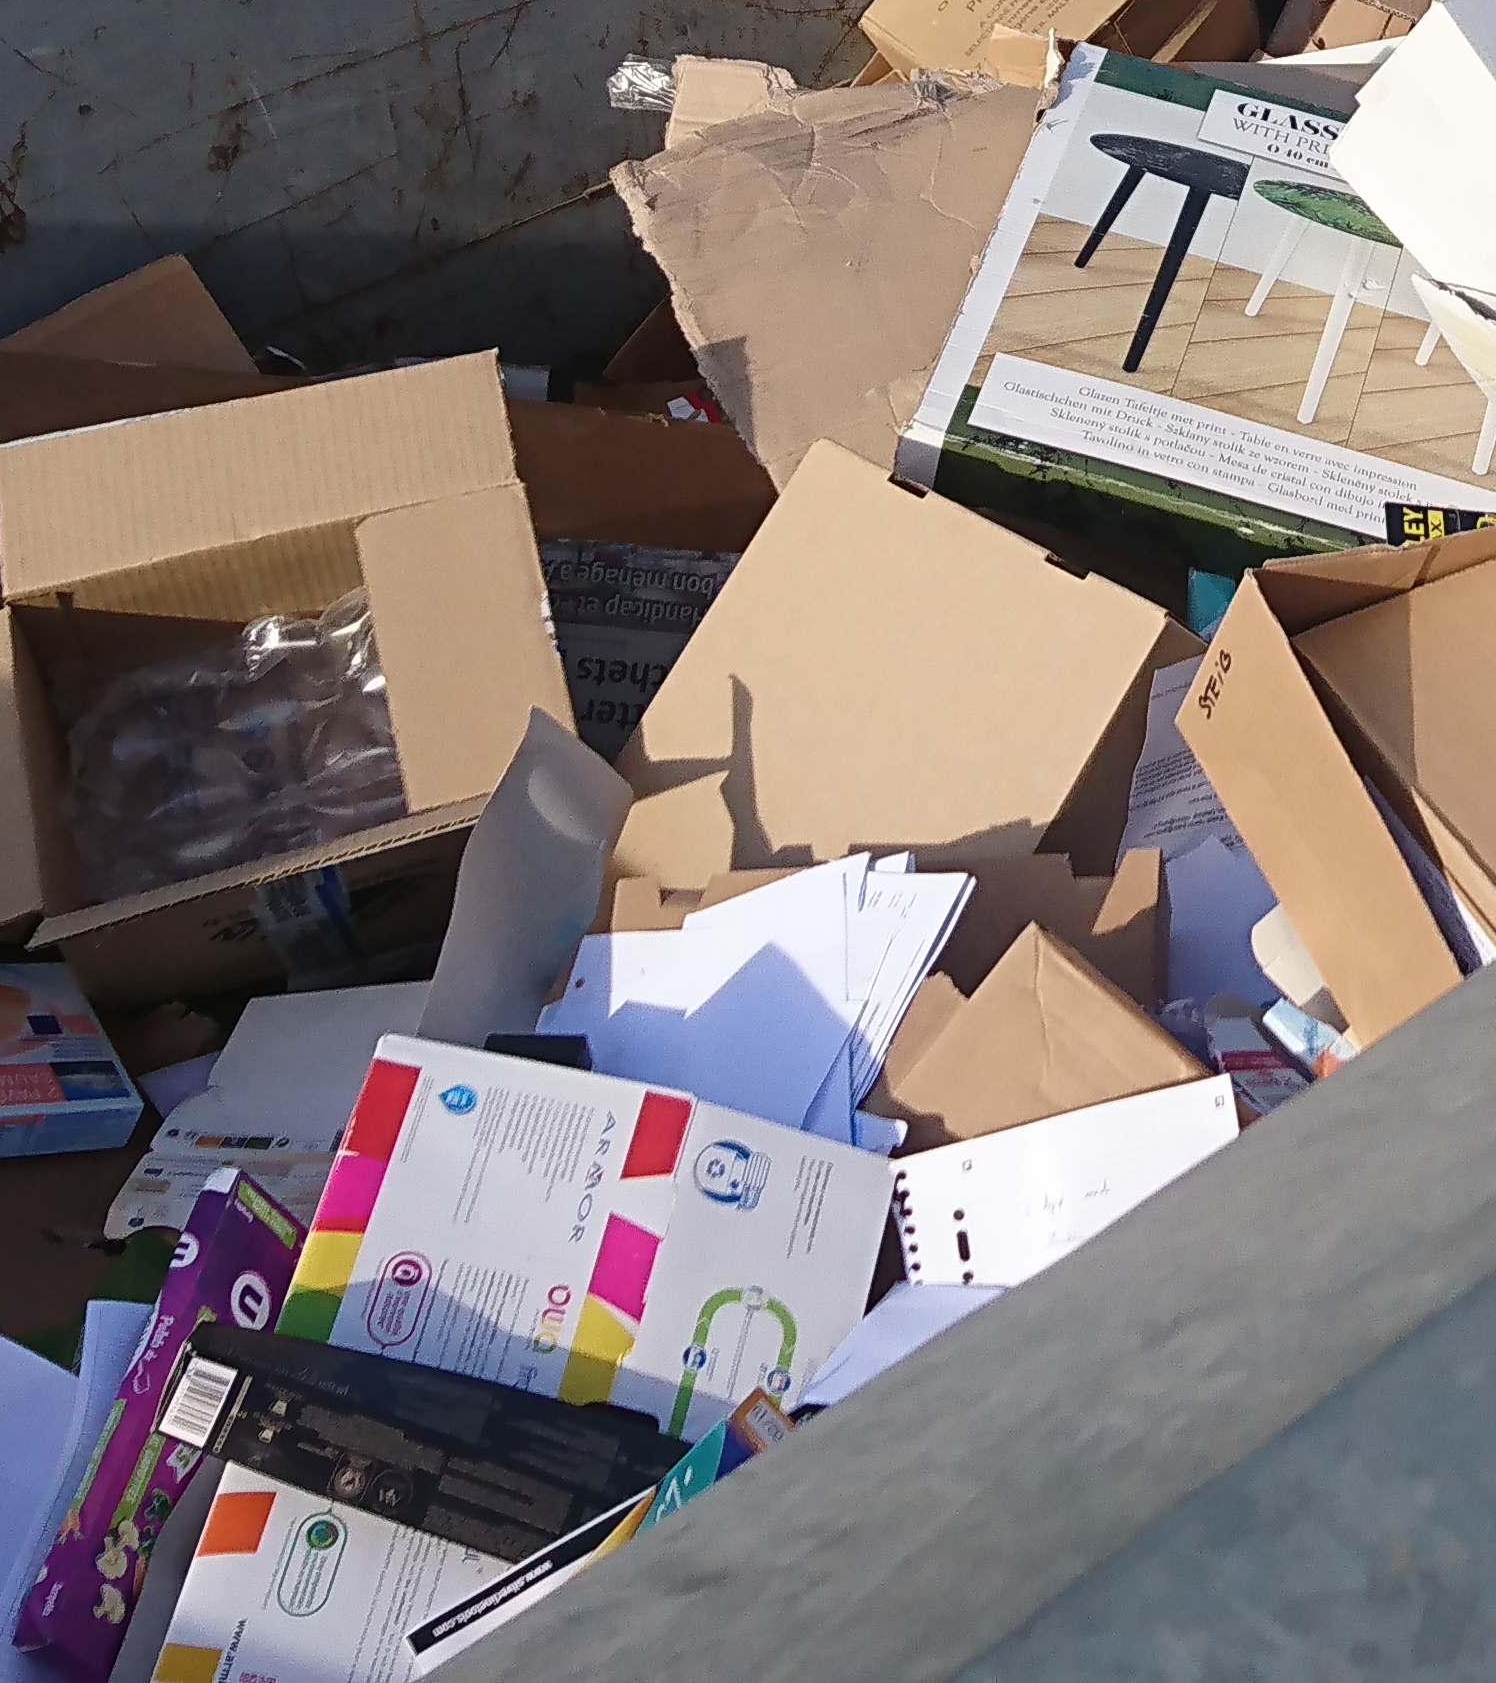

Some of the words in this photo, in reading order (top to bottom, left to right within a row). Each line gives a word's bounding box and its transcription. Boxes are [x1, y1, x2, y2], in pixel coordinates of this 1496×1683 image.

[1232, 117, 1291, 145] WITH
[1296, 136, 1331, 155] PRI
[1237, 102, 1342, 141] GLASS
[1284, 148, 1304, 161] 40
[1305, 156, 1330, 169] cm
[1003, 380, 1089, 412] Glastischchen
[1090, 404, 1113, 418] mit
[1115, 409, 1155, 429] Druck
[1248, 449, 1262, 459] ze
[1264, 454, 1311, 475] wzorem
[1378, 484, 1415, 504] stolek
[1078, 385, 1121, 406] Glazen
[1125, 396, 1169, 420] Tafeltje
[1170, 411, 1195, 427] met
[1196, 419, 1228, 436] print
[1239, 430, 1273, 449] Table
[1274, 442, 1290, 455] en
[1293, 448, 1323, 465] verre
[1324, 456, 1351, 472] avec
[1081, 429, 1134, 452] Tavolino
[1136, 445, 1150, 458] in
[1152, 450, 1185, 466] vetro
[1186, 460, 1210, 474] con
[1211, 467, 1256, 489] stampa
[1267, 482, 1324, 508] Glasbord
[1326, 499, 1354, 515] med
[1218, 452, 1249, 471] Mesa
[1252, 462, 1268, 475] de
[1270, 468, 1308, 488] cristal
[1309, 481, 1333, 495] con
[1334, 486, 1374, 509] dibujo
[576, 656, 667, 693] chets
[568, 1109, 618, 1244] ARMOR
[217, 1617, 248, 1683] www.arm
